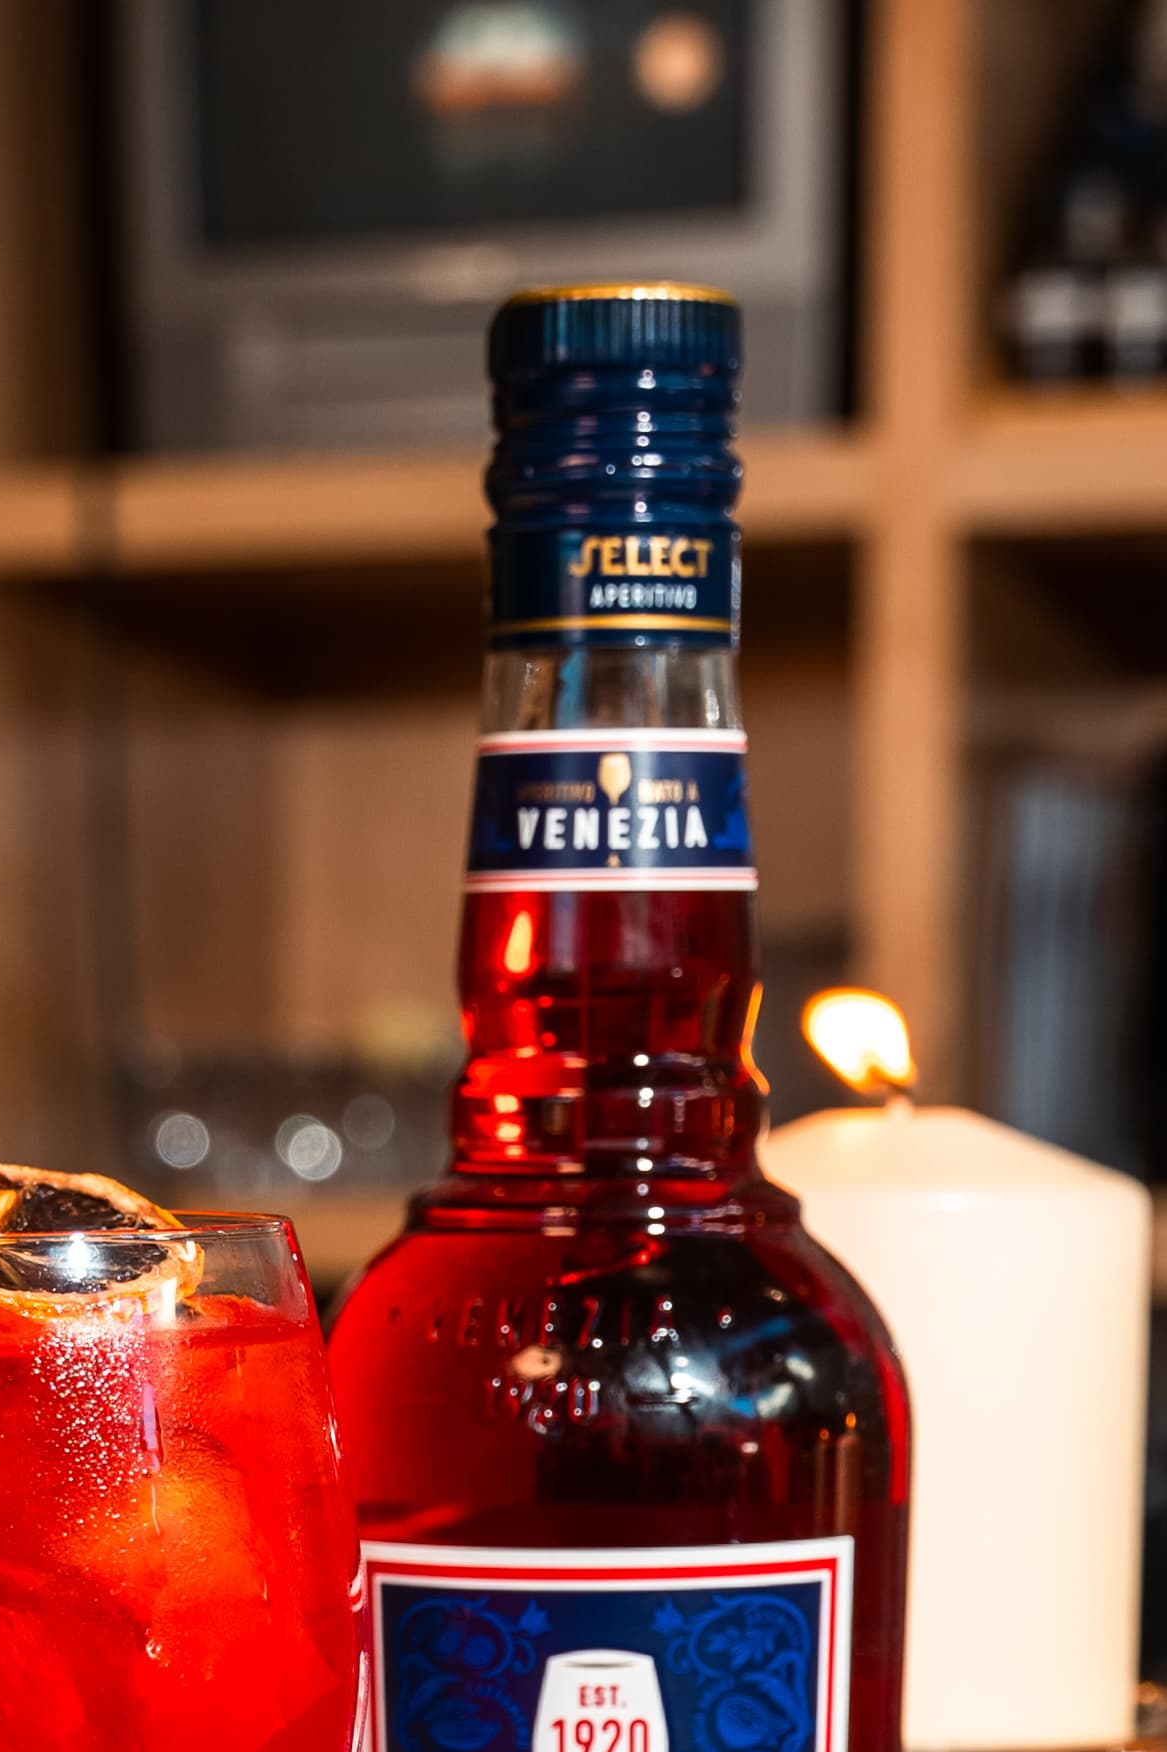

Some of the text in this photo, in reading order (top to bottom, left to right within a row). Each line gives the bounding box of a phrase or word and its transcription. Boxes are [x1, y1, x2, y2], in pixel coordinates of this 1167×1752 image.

[568, 536, 712, 577] SELECT
[589, 583, 697, 609] APERITIVO
[517, 805, 708, 850] VENEZIA
[578, 1684, 628, 1709] EST.
